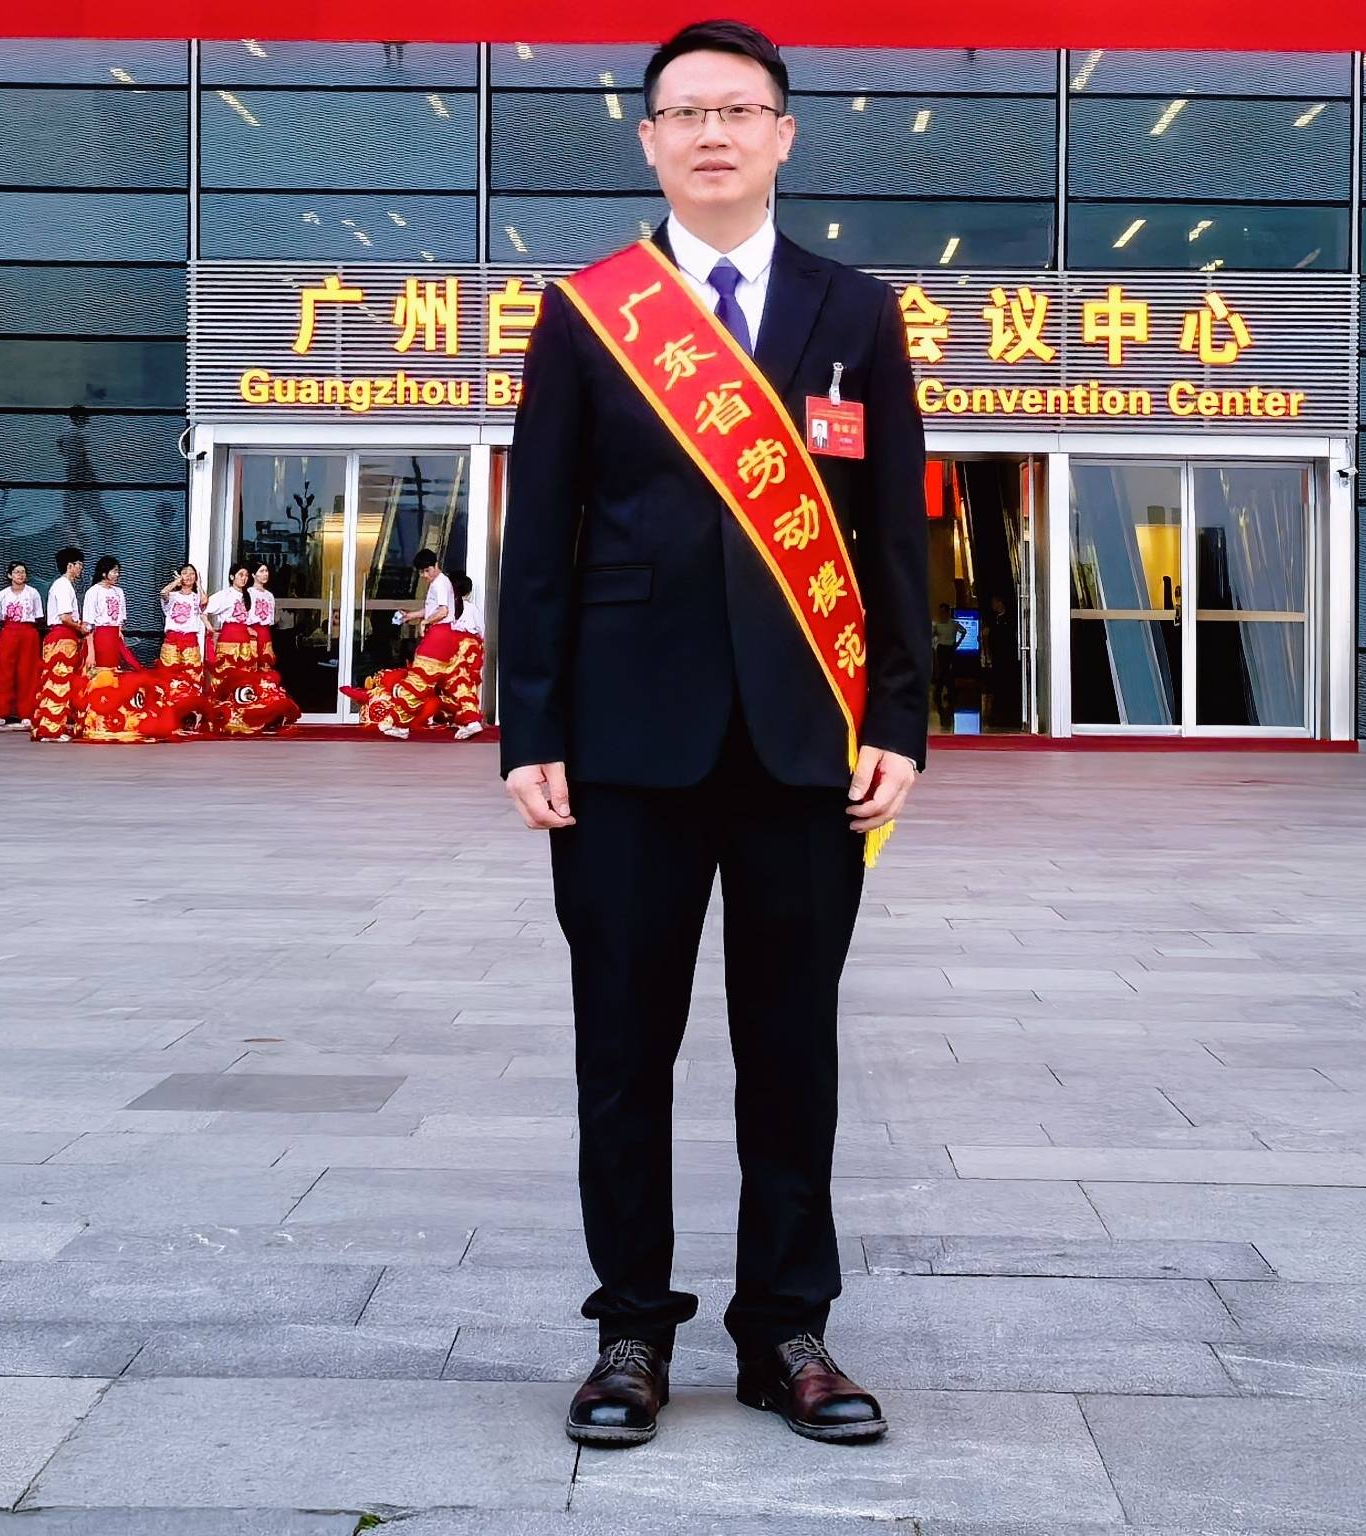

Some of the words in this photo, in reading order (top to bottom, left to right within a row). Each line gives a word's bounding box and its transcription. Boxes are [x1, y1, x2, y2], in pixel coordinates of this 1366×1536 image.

[239, 368, 471, 412] Guangzhou
[916, 378, 1152, 416] Convention
[1167, 379, 1307, 417] Center
[618, 280, 867, 679] 广东省劳动模范
